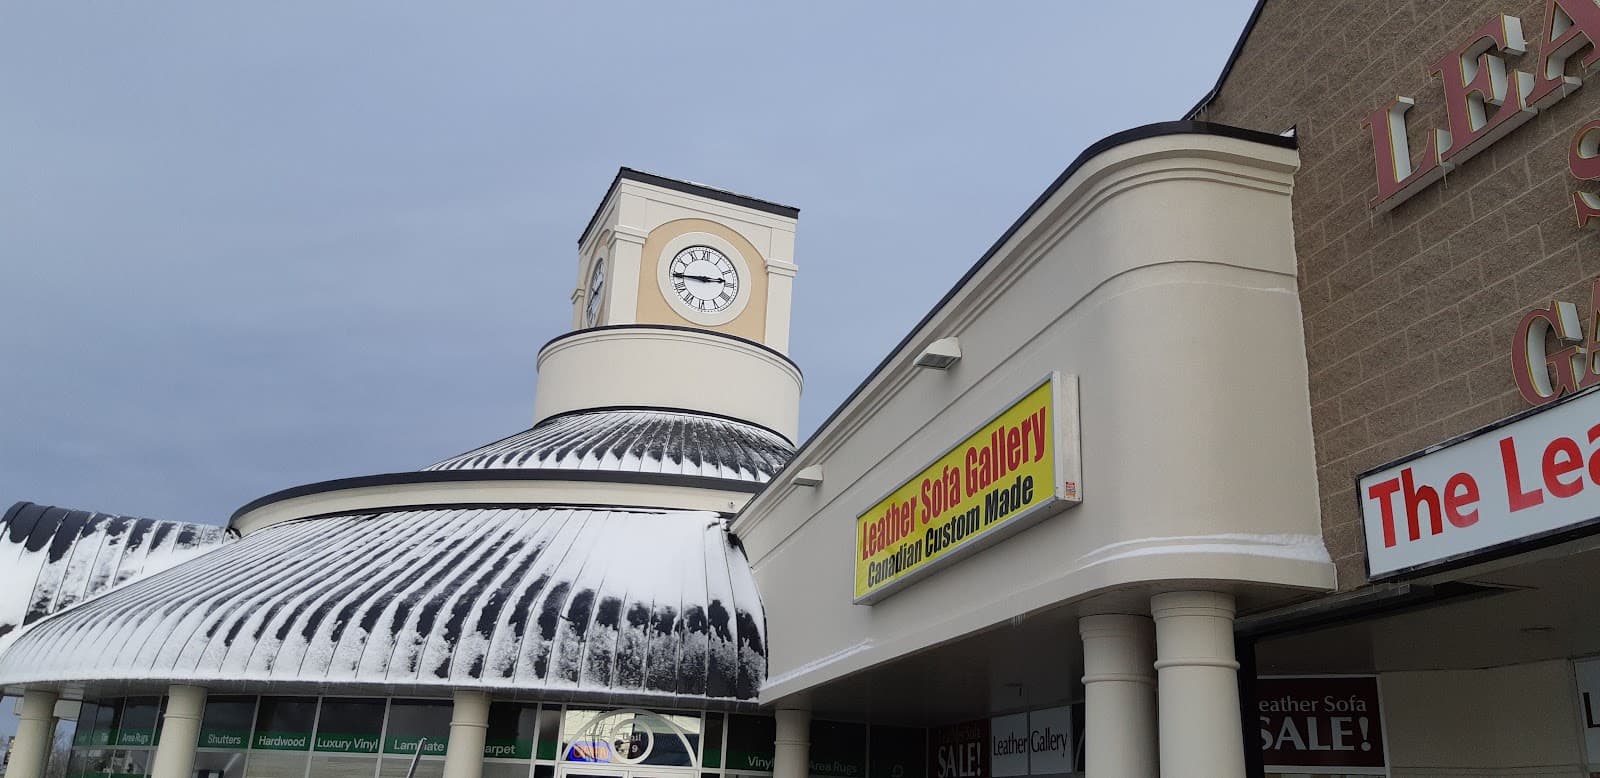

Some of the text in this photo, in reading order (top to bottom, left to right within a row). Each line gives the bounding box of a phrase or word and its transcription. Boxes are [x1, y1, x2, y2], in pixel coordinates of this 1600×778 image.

[862, 406, 1046, 561] Leather Sofa Gallery
[1368, 466, 1480, 549] The
[867, 474, 1034, 588] Canadian Custom Made
[1258, 693, 1367, 712] eather Sofa
[207, 733, 242, 745] Shutters
[258, 735, 306, 748] Hardwood
[993, 730, 1028, 757] Leather
[1031, 726, 1068, 758] Gallery
[1259, 715, 1372, 752] SALE!
[317, 737, 379, 752] Luxury Vinyl
[393, 739, 445, 752] Lamate
[484, 742, 517, 757] arpet
[631, 744, 639, 753] 9
[937, 741, 982, 778] SALE!
